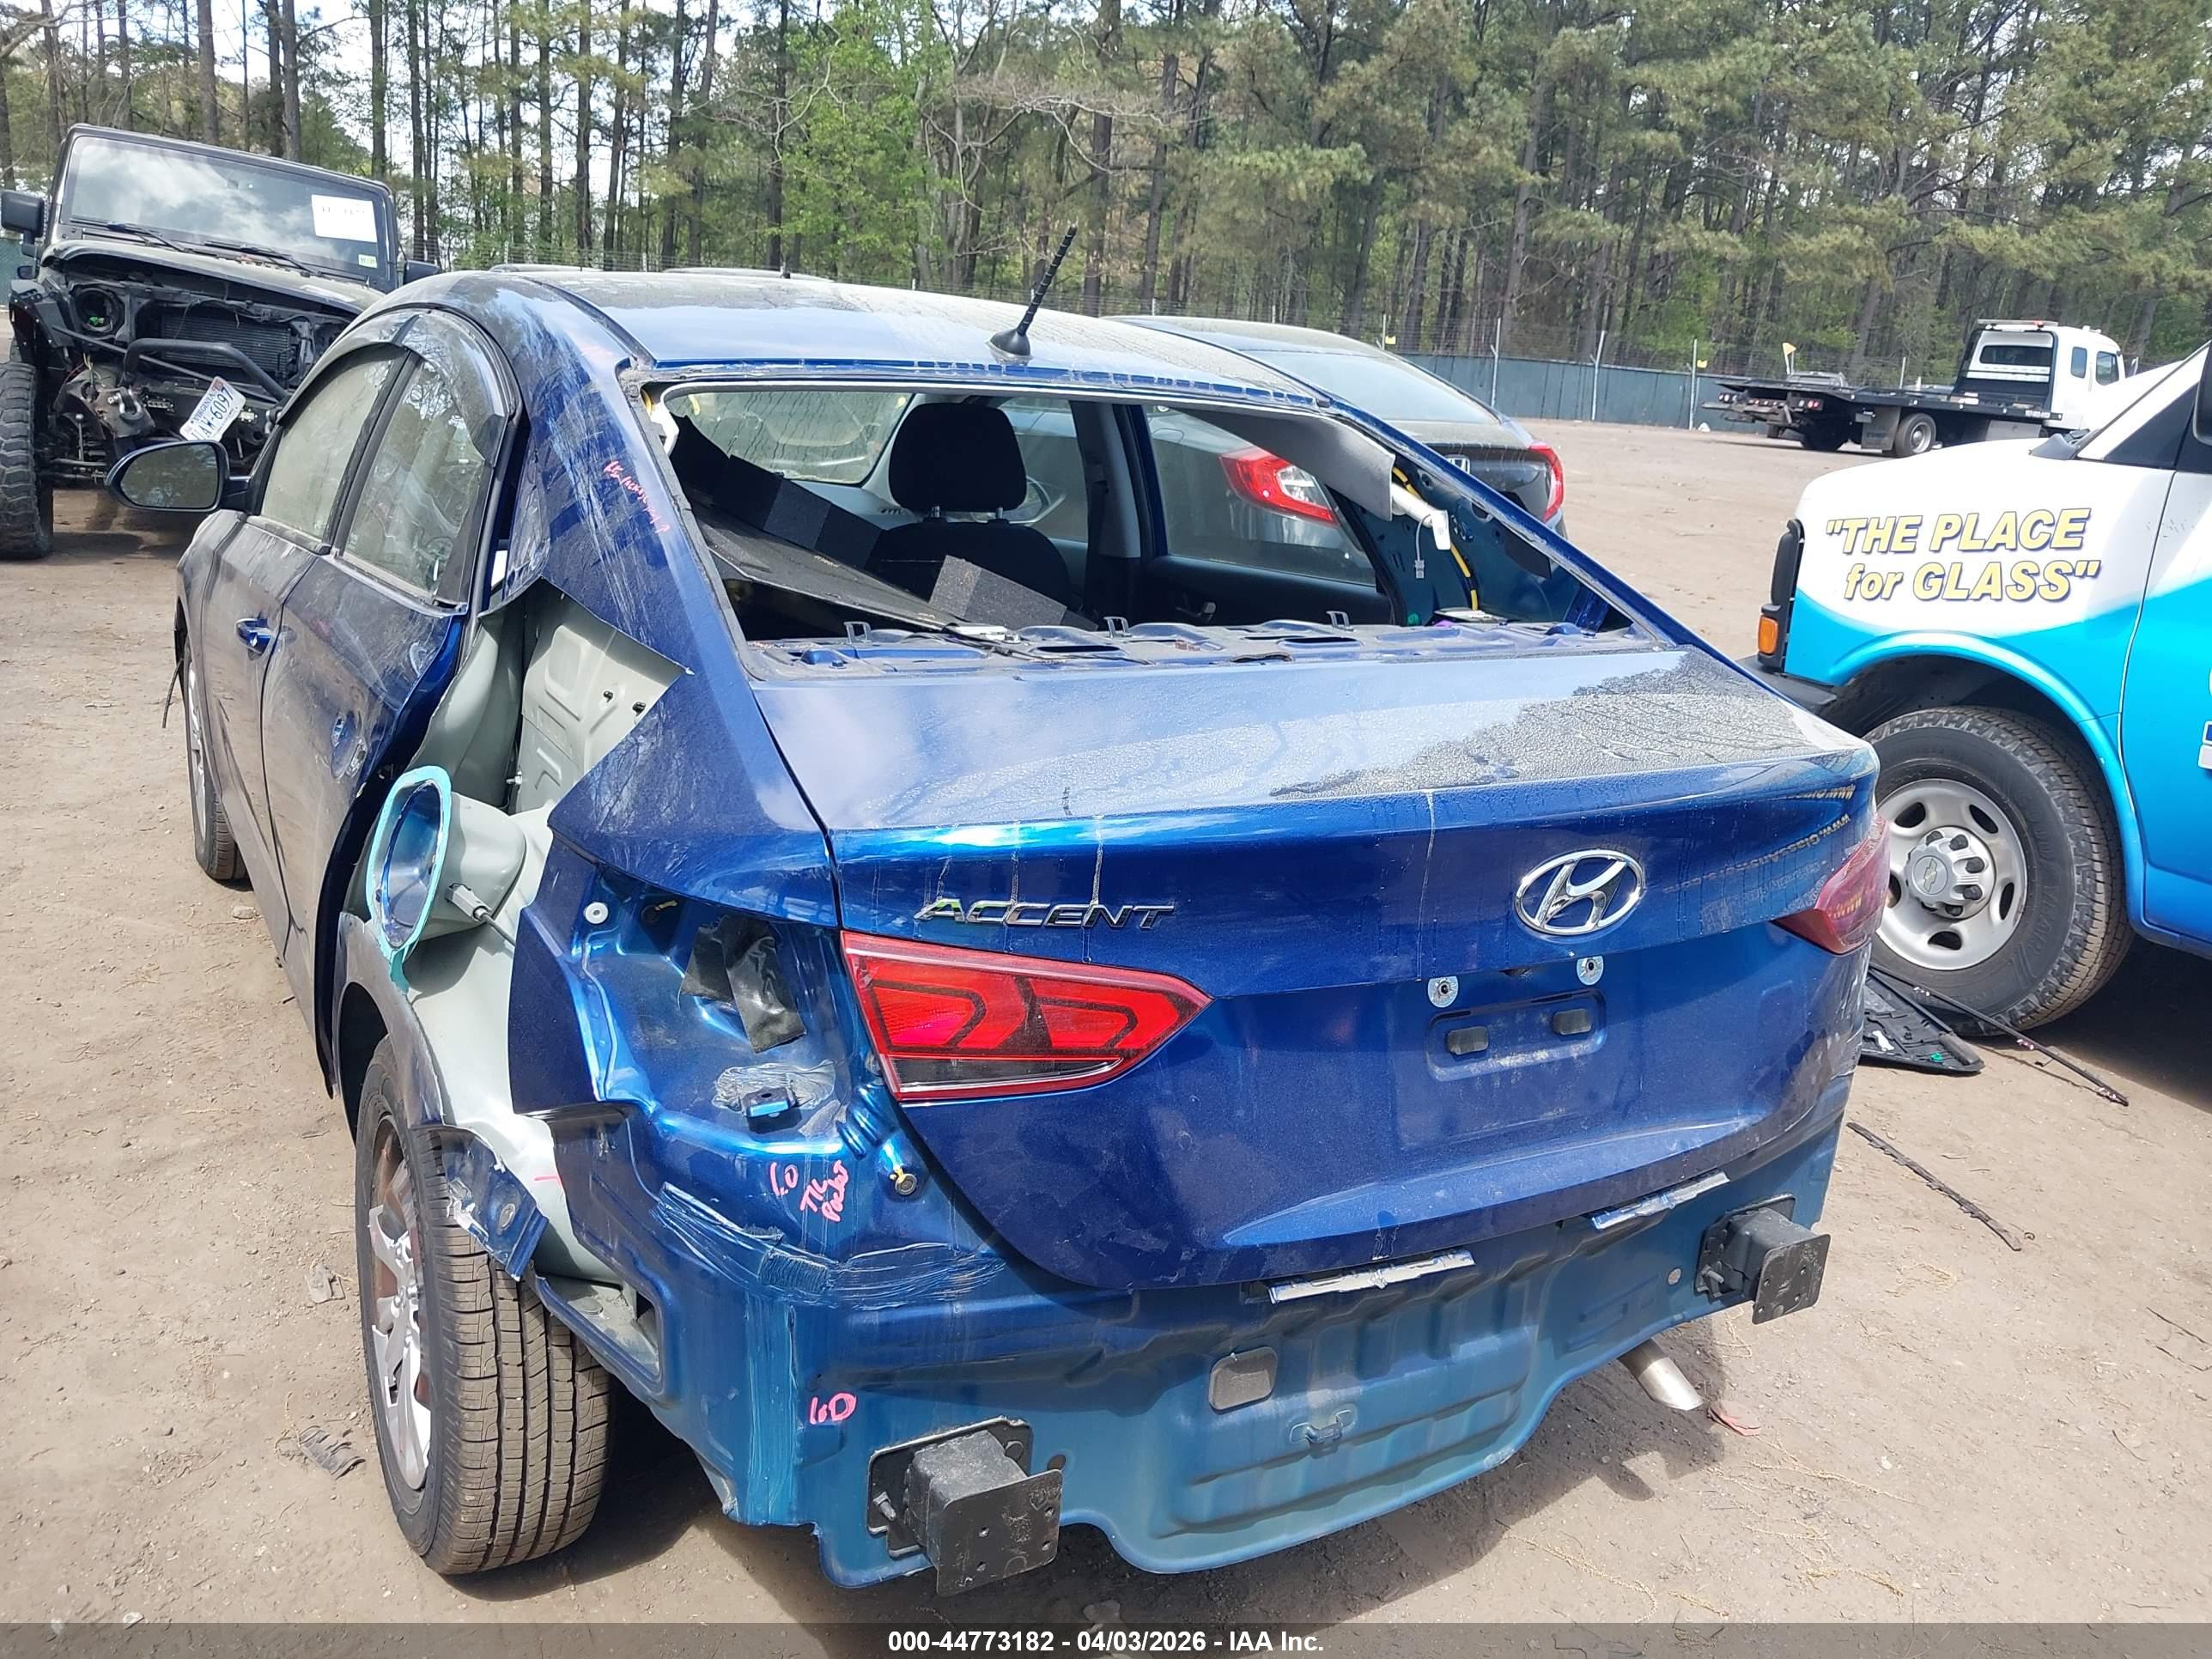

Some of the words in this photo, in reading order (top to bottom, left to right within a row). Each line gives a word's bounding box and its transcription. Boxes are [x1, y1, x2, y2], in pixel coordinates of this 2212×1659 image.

[193, 392, 216, 422] VIRGINIA
[1826, 514, 1923, 554] "THE
[1929, 507, 2092, 552] PLACE
[1844, 562, 1905, 601] for
[1912, 559, 2101, 602] GLASS"
[914, 898, 1175, 928] ACCENT
